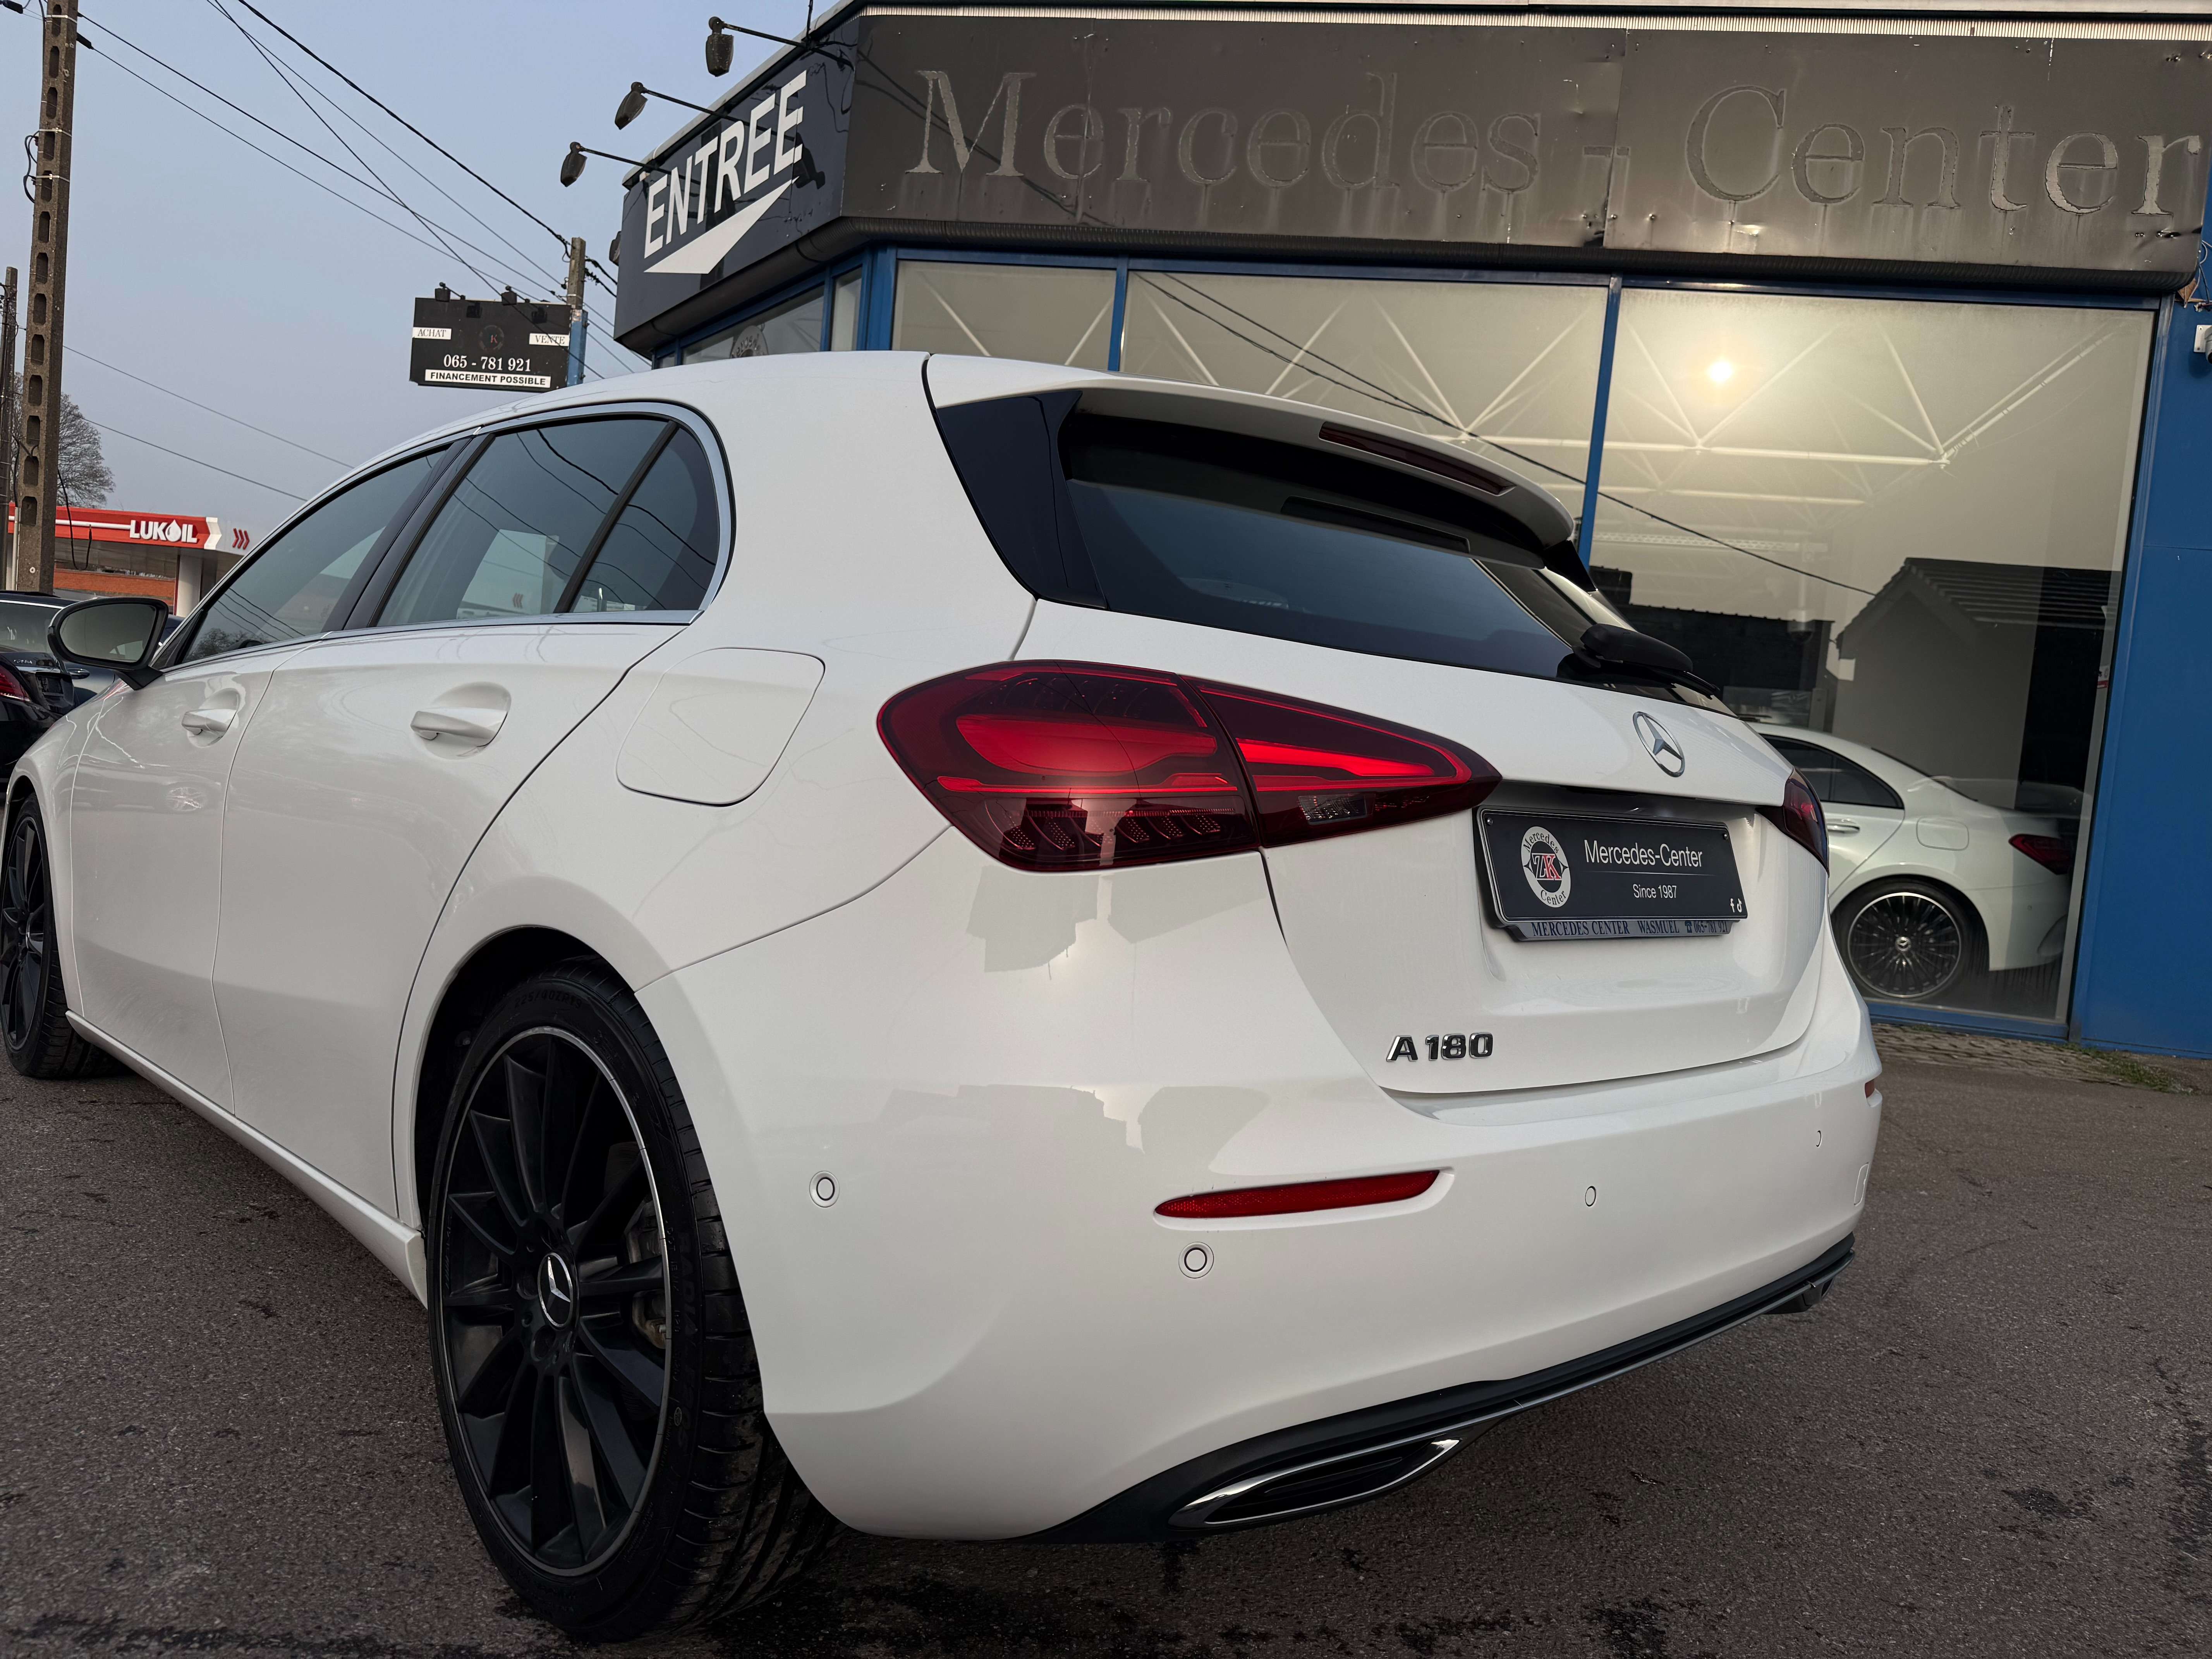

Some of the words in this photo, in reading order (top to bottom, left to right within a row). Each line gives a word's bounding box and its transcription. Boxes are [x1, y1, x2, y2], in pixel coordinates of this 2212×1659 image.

[905, 70, 1540, 193] Mercedes
[1686, 85, 2201, 216] Center
[644, 70, 806, 258] ENTREE
[417, 328, 446, 337] ACHAT
[535, 335, 565, 344] VENTE
[443, 354, 467, 368] 065
[481, 356, 503, 370] 781
[508, 358, 531, 371] 921
[430, 372, 497, 382] FINANCEMENT
[500, 376, 546, 385] POSSIBLE
[129, 519, 197, 543] LUKOIL
[1523, 832, 1559, 853] Mercedes
[1584, 840, 1702, 867] Mercedes-Center
[1540, 890, 1566, 905] Center
[1633, 884, 1656, 898] Since
[1658, 885, 1676, 898] 1987
[1531, 921, 1589, 936] MERCEDES
[1592, 920, 1630, 934] CENTER
[1637, 920, 1680, 934] WASMUEL
[1718, 920, 1728, 933] 921
[1386, 1035, 1418, 1062] A
[1425, 1032, 1493, 1061] 180
